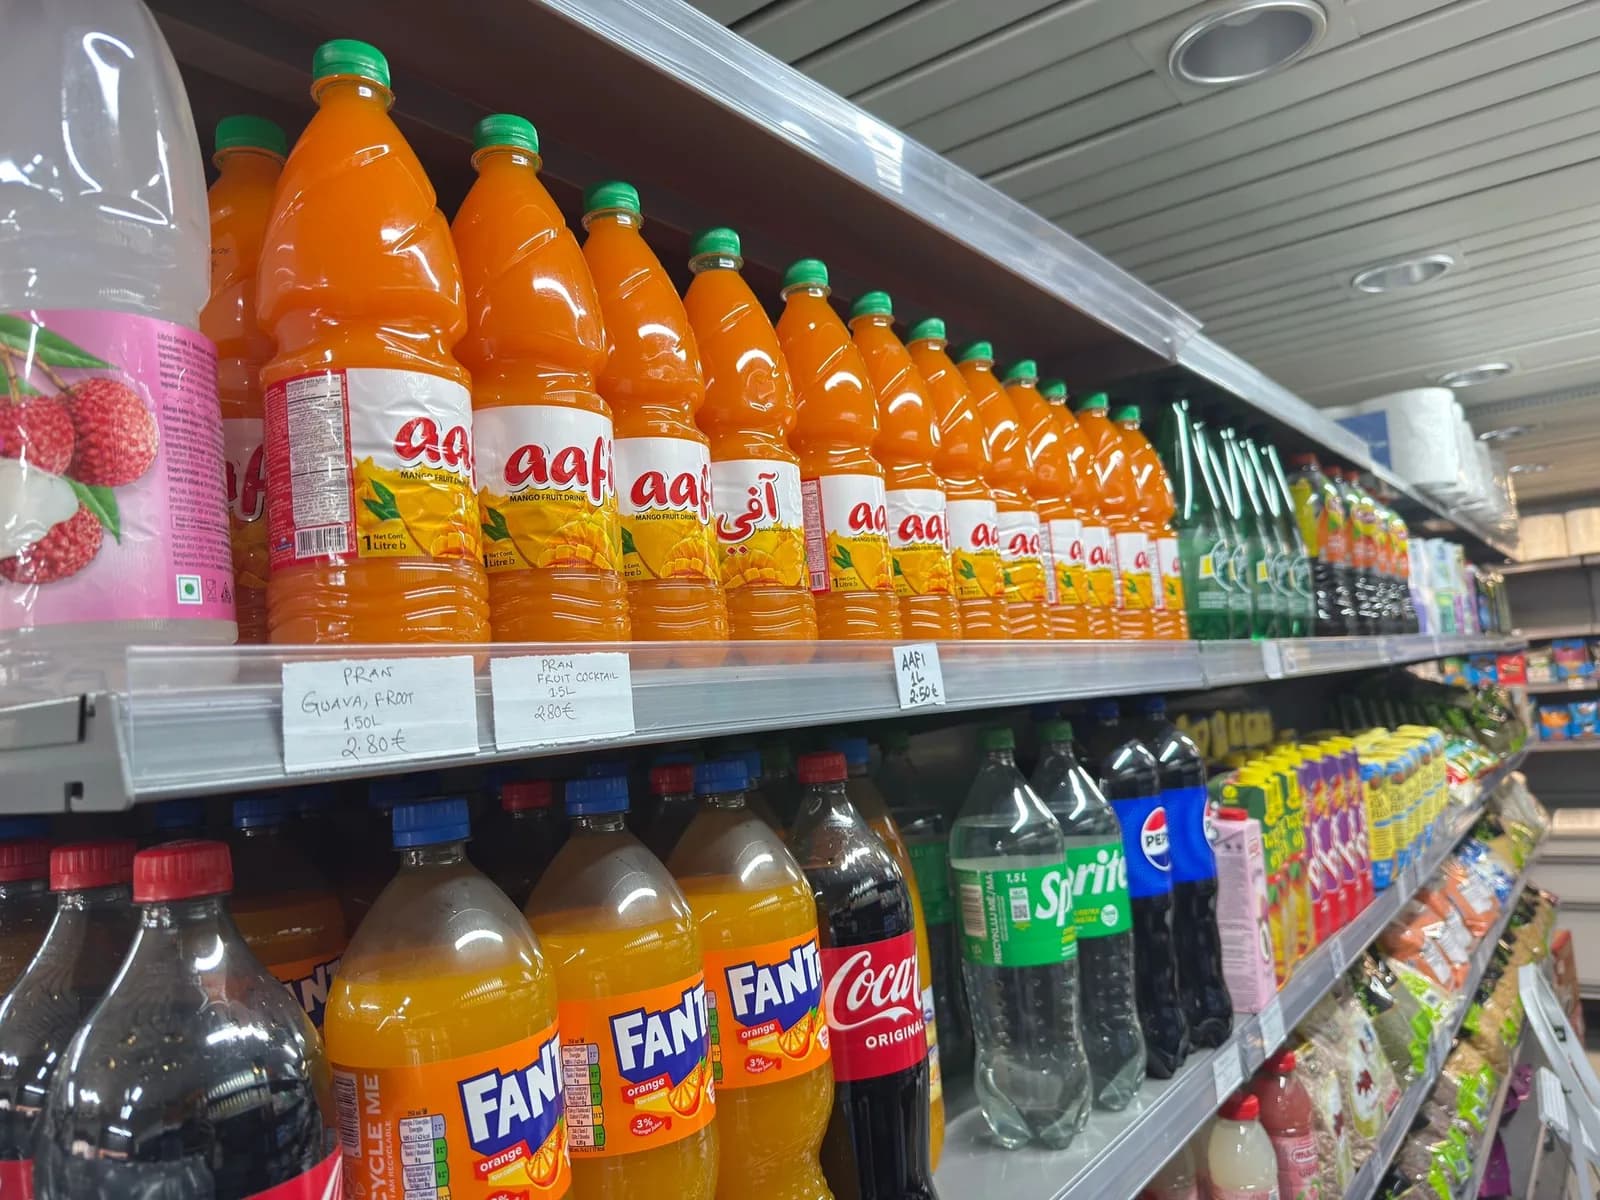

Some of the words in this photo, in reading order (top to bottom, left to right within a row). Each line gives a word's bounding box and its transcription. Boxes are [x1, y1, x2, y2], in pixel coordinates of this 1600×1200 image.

[394, 416, 477, 492] aa
[510, 494, 540, 503] MANGO
[542, 494, 563, 502] FRUIT
[564, 494, 586, 502] DRINK
[630, 464, 713, 521] aaf
[717, 472, 778, 555] آفي
[362, 534, 372, 552] 1
[374, 541, 398, 550] Litre
[489, 557, 508, 568] Litre
[542, 658, 573, 672] PRAN
[902, 650, 926, 672] AAFI
[344, 666, 393, 686] PRAN
[538, 674, 571, 685] FRUIT
[576, 672, 620, 682] COCKTAIL
[911, 672, 925, 687] 1L
[375, 689, 415, 708] FROOT
[1021, 872, 1028, 882] L
[613, 982, 709, 1072] FANT
[741, 1024, 775, 1038] orange
[866, 1019, 924, 1050] ORIGINAL
[750, 1057, 765, 1067] 3%
[364, 1074, 382, 1115] ME
[627, 1078, 665, 1097] orange
[636, 1117, 654, 1128] 3%
[480, 1146, 522, 1172] orange
